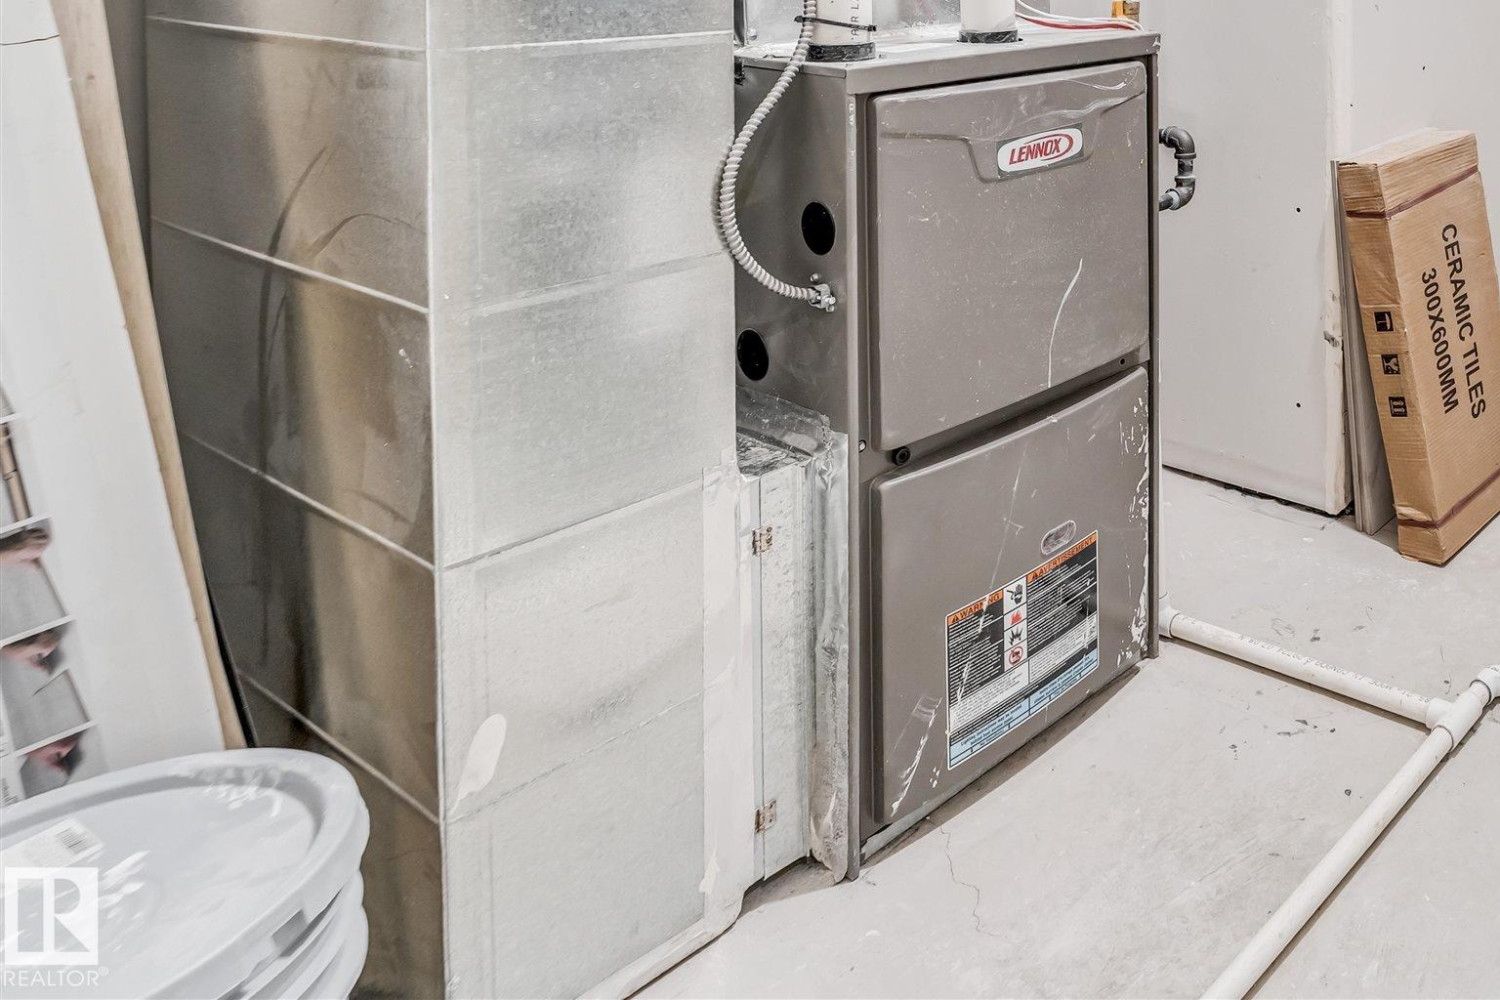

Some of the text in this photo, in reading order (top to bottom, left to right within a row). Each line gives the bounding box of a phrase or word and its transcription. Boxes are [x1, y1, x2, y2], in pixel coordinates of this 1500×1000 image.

[1009, 138, 1062, 165] LENNOX
[1421, 268, 1459, 414] 300X600MM
[1441, 223, 1486, 420] CERAMIC TILES
[959, 593, 1001, 620] WARNNG
